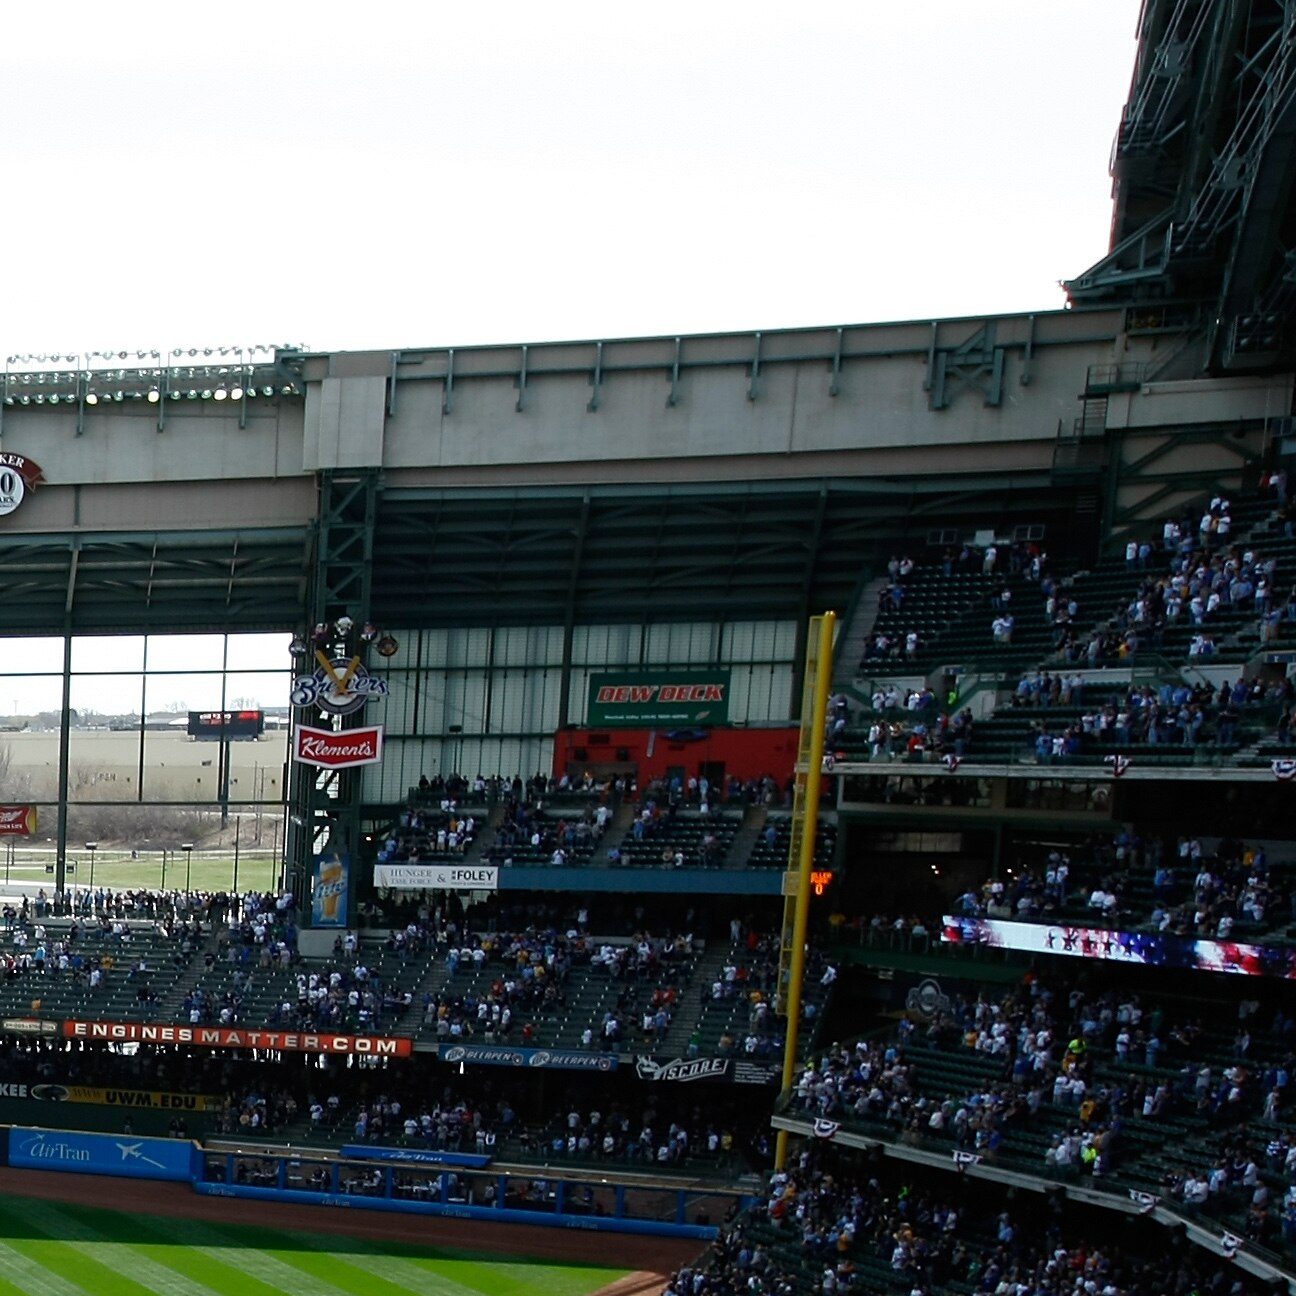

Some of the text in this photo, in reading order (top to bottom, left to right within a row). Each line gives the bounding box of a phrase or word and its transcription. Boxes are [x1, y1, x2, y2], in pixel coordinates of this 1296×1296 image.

[596, 684, 724, 703] DEW DECK
[302, 736, 374, 756] Klement's
[391, 869, 432, 877] HUNGER
[458, 870, 494, 881] FOLEY
[30, 1141, 90, 1161] airTran
